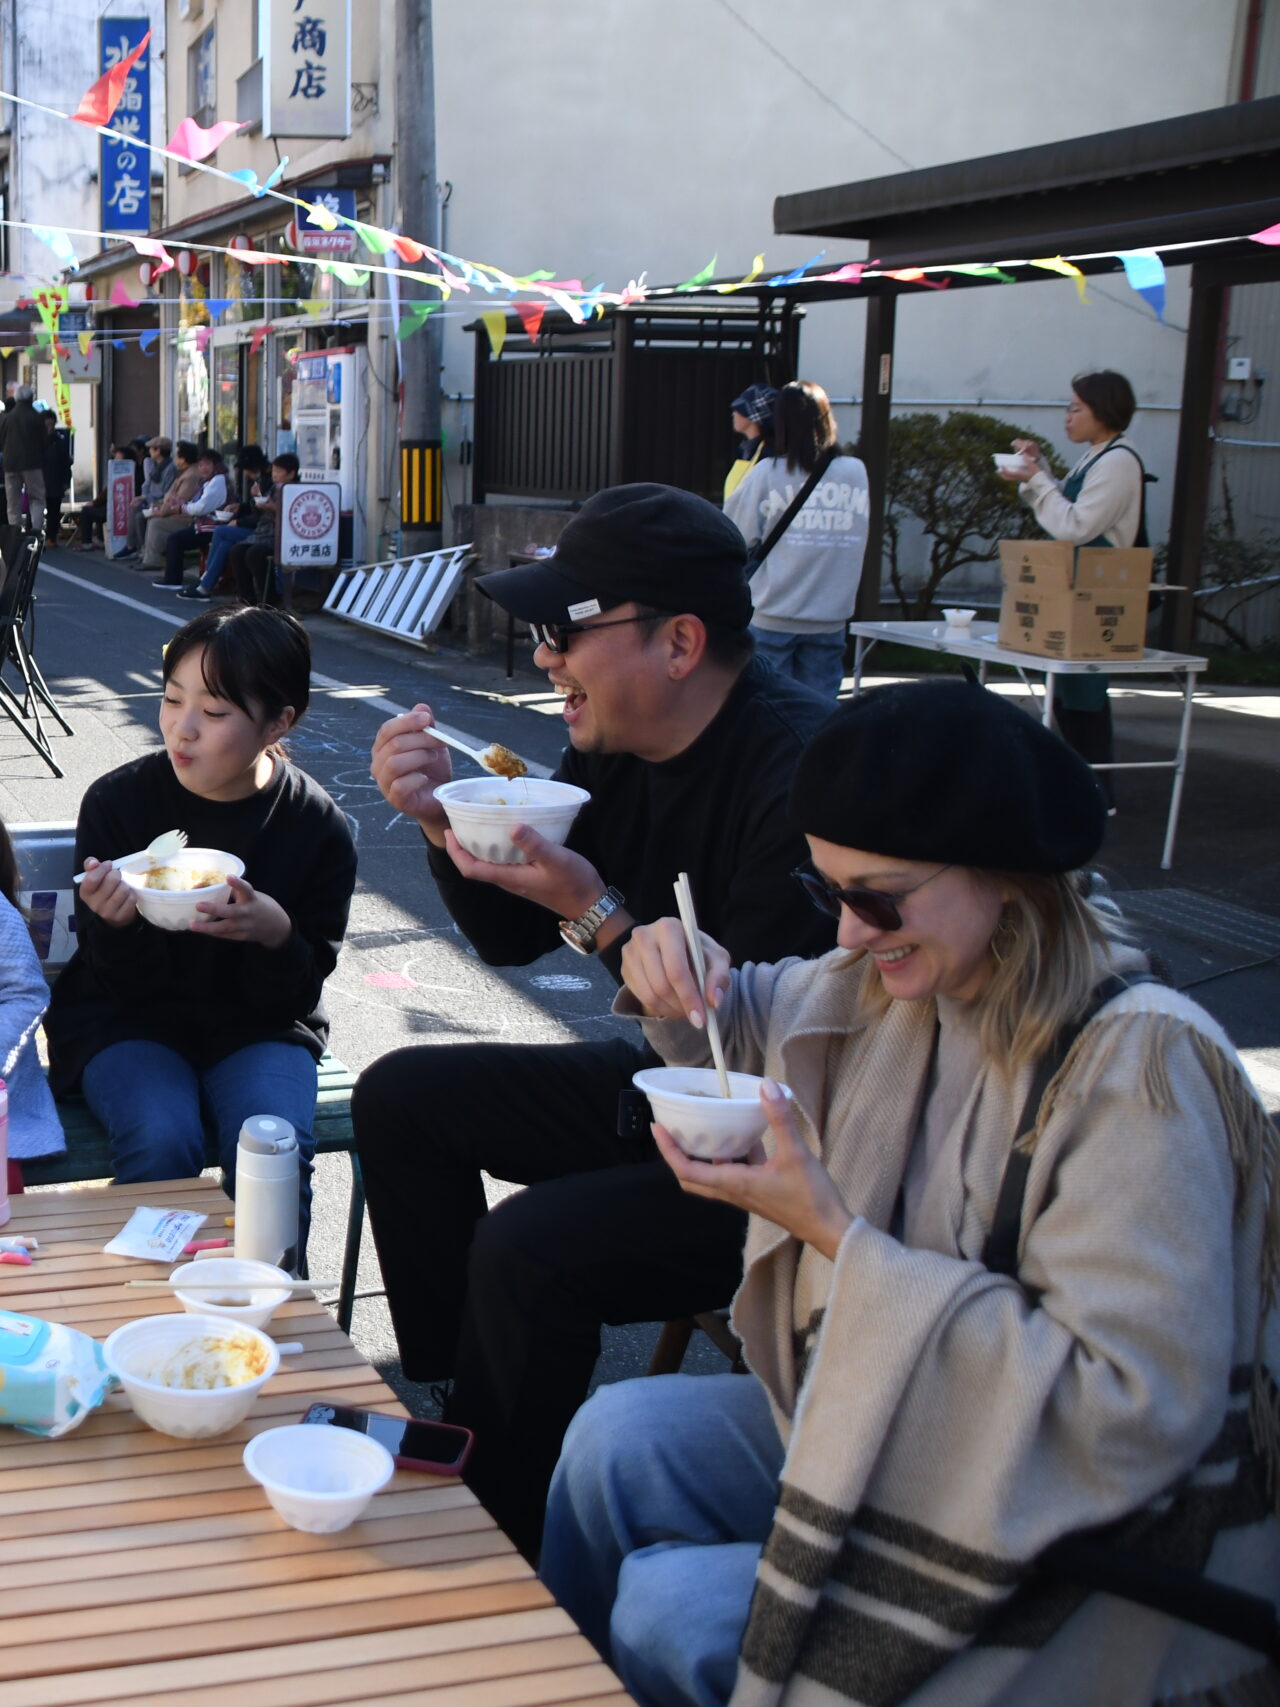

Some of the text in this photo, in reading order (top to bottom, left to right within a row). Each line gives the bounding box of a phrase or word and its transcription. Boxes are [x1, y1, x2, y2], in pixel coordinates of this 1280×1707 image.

[289, 0, 326, 98] 商店
[104, 36, 147, 214] 水晶米の店
[289, 544, 332, 557] 宍戸酒店
